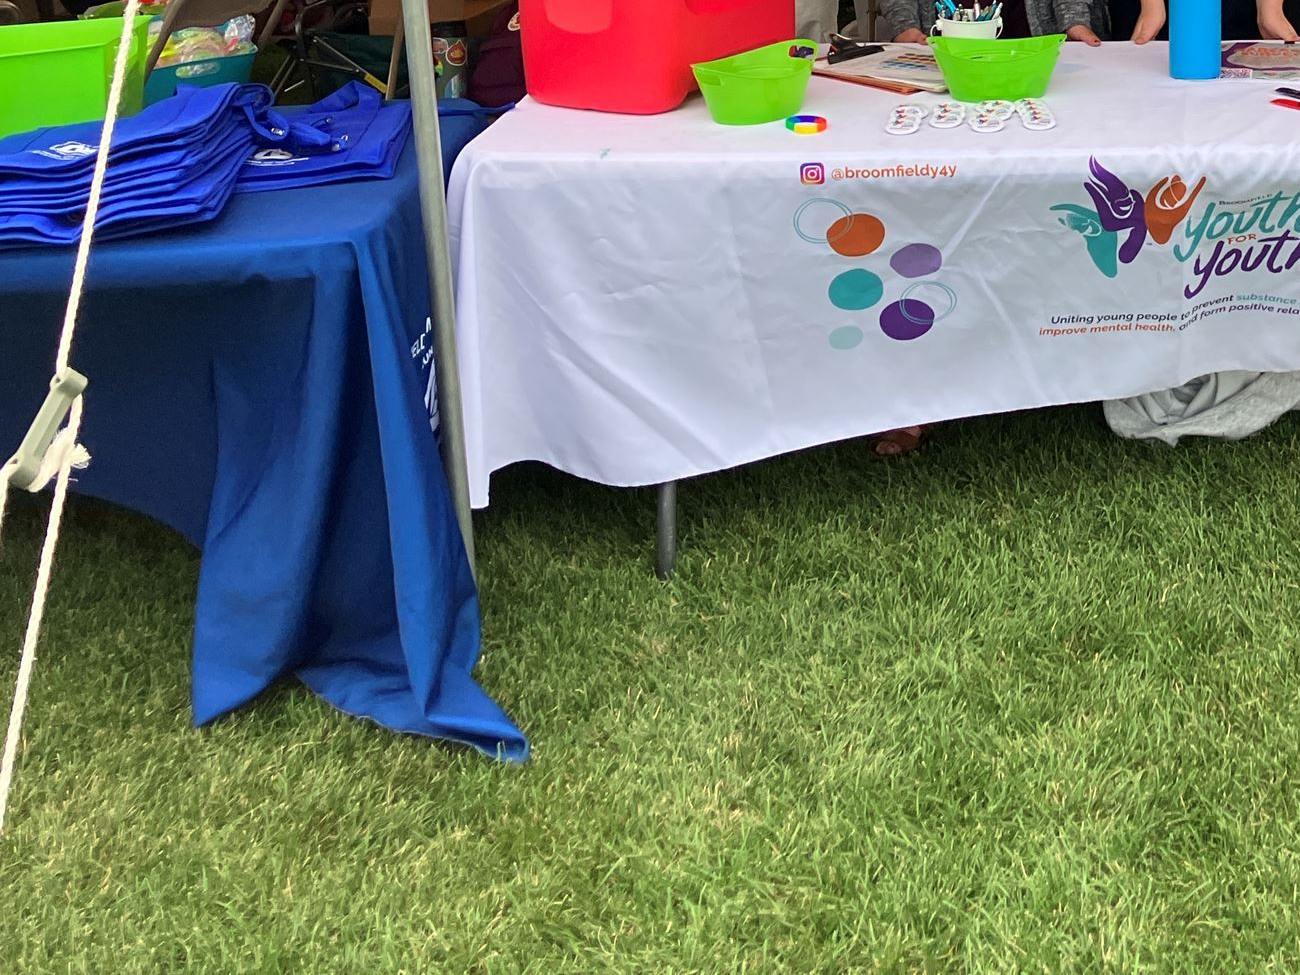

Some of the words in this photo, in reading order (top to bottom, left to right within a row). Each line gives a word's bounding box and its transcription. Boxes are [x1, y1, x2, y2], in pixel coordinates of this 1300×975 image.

[831, 164, 957, 181] @broomfieldy4y
[1227, 233, 1257, 245] FOR
[1039, 327, 1088, 337] improve
[1089, 323, 1133, 333] mental
[1178, 315, 1198, 331] and
[1199, 306, 1226, 321] form
[1228, 303, 1274, 313] positive
[1051, 315, 1094, 325] Uniting
[1096, 313, 1134, 324] young
[1136, 312, 1178, 322] people
[1180, 312, 1191, 321] to
[1191, 294, 1234, 315] prevent
[1236, 293, 1297, 305] substance
